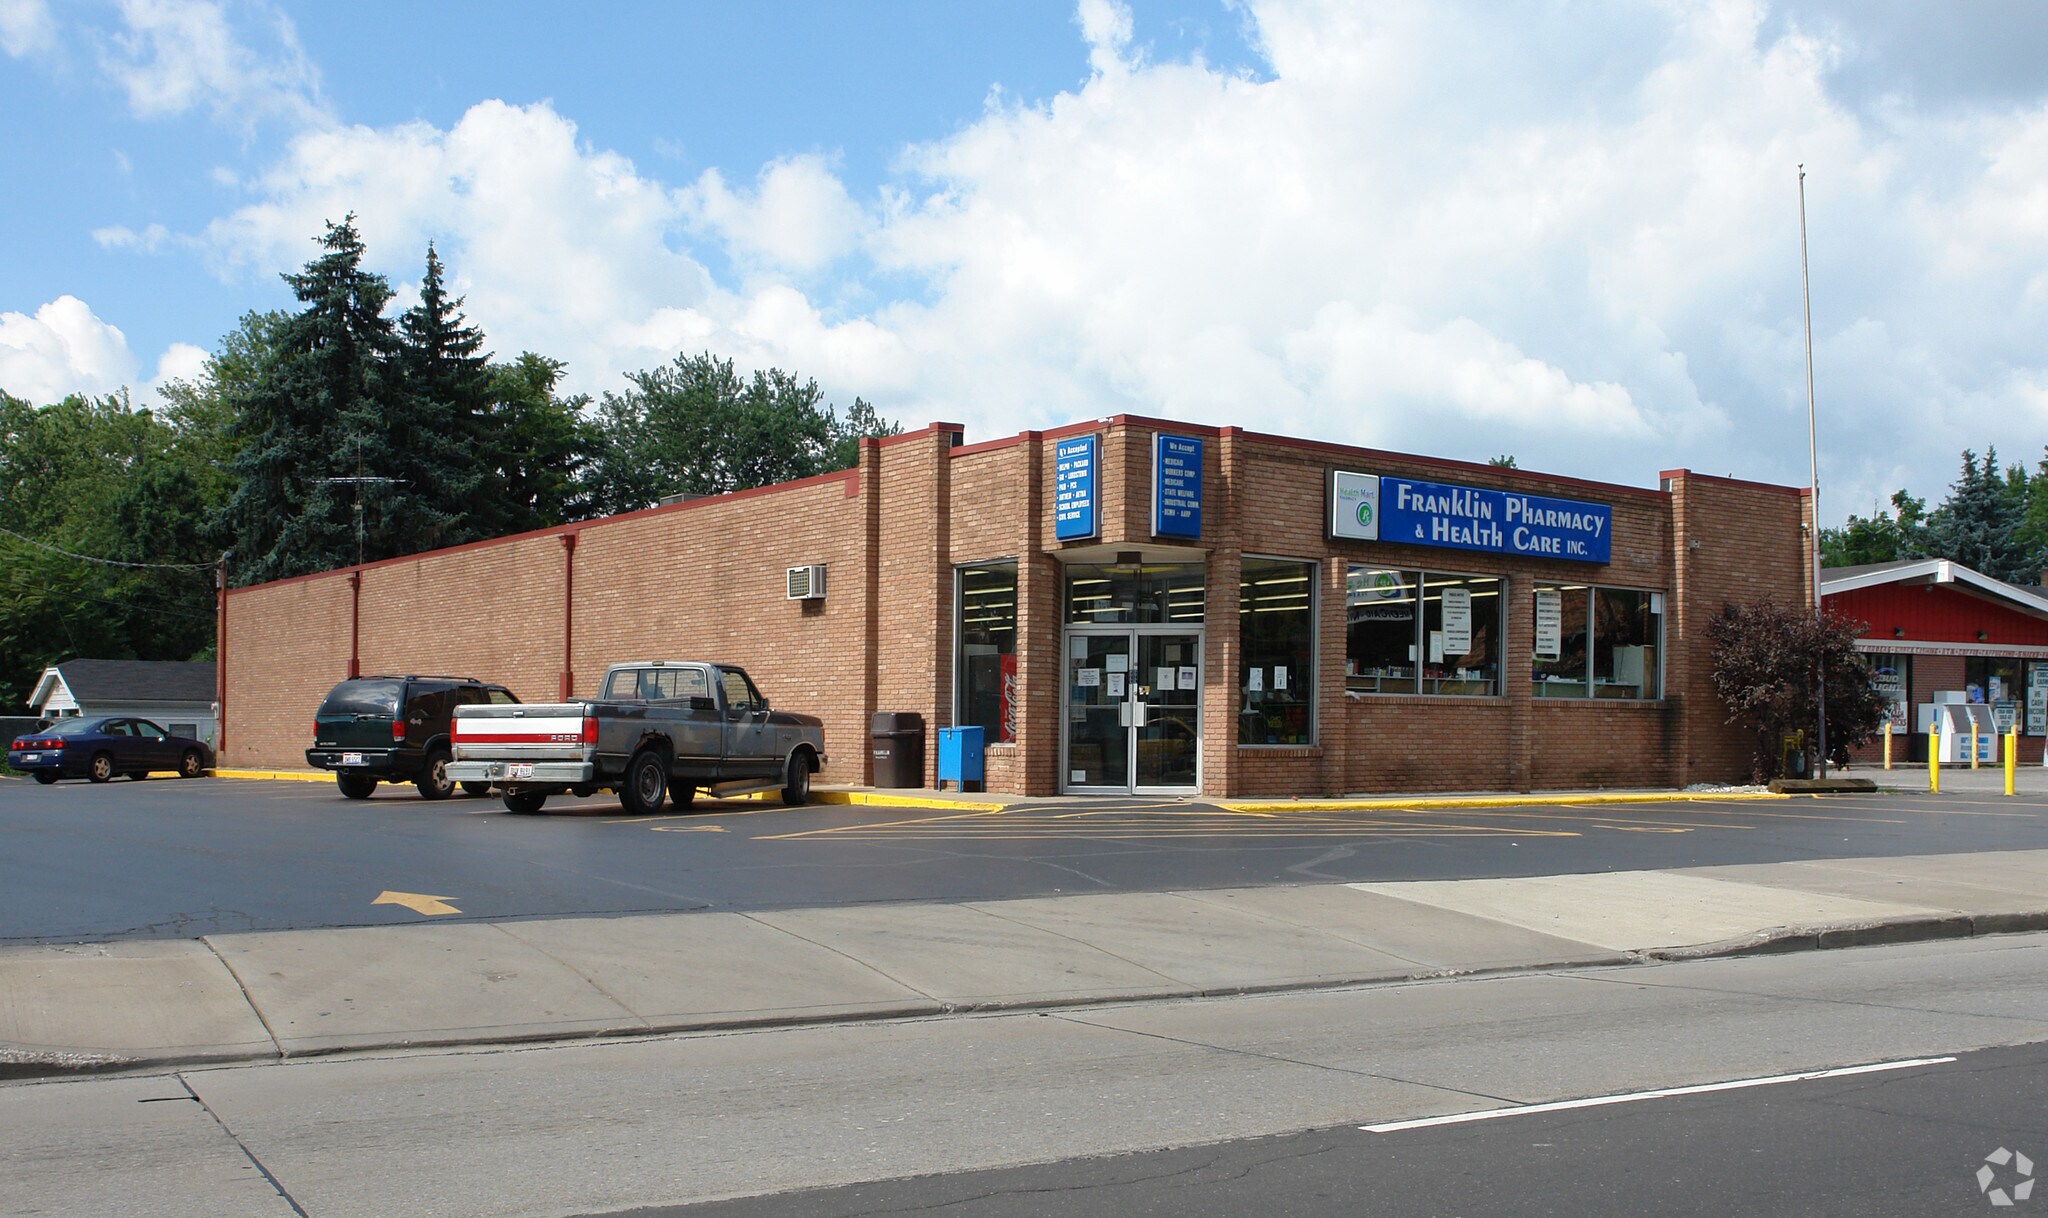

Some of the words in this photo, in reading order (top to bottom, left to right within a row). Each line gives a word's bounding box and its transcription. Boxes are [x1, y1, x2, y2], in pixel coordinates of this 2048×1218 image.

[1067, 443, 1088, 454] Accepted
[1178, 443, 1194, 452] Accept
[1164, 458, 1184, 466] MEDICAID
[1165, 468, 1184, 476] WORKERS
[1177, 490, 1194, 498] WELFARE
[1414, 524, 1424, 539] &
[1567, 540, 1588, 556] INC.
